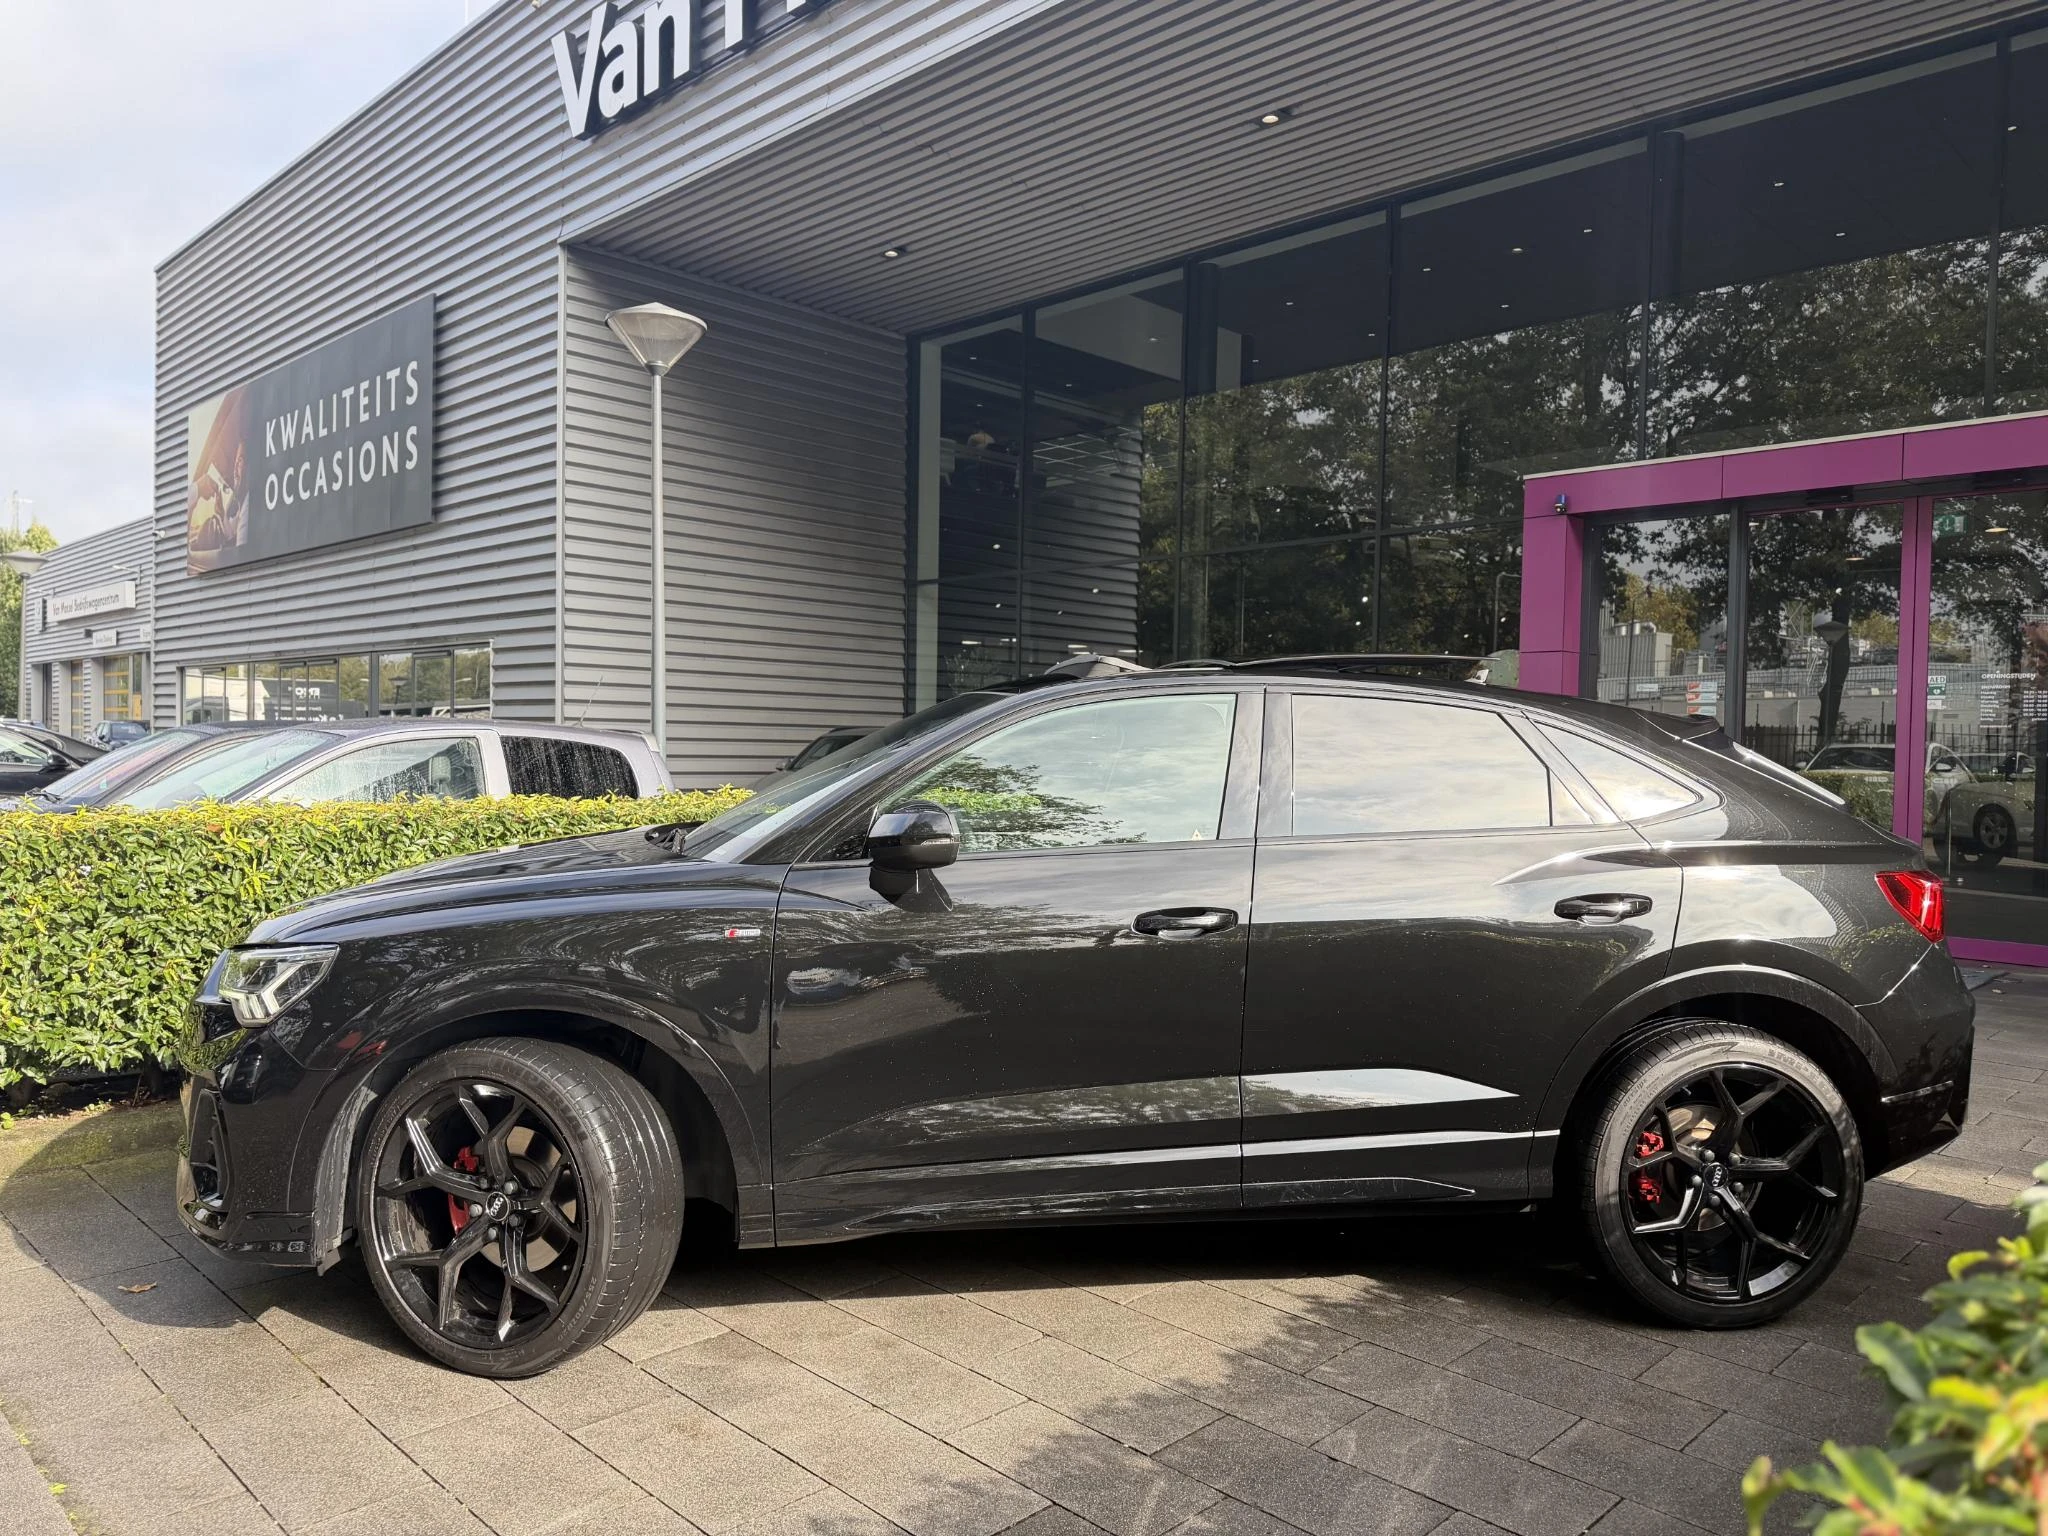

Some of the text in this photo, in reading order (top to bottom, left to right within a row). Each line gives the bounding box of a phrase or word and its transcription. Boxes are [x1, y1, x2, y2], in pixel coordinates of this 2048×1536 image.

[551, 0, 690, 138] Van
[265, 360, 419, 457] KWALITEITS
[265, 425, 418, 510] OCCASIONS
